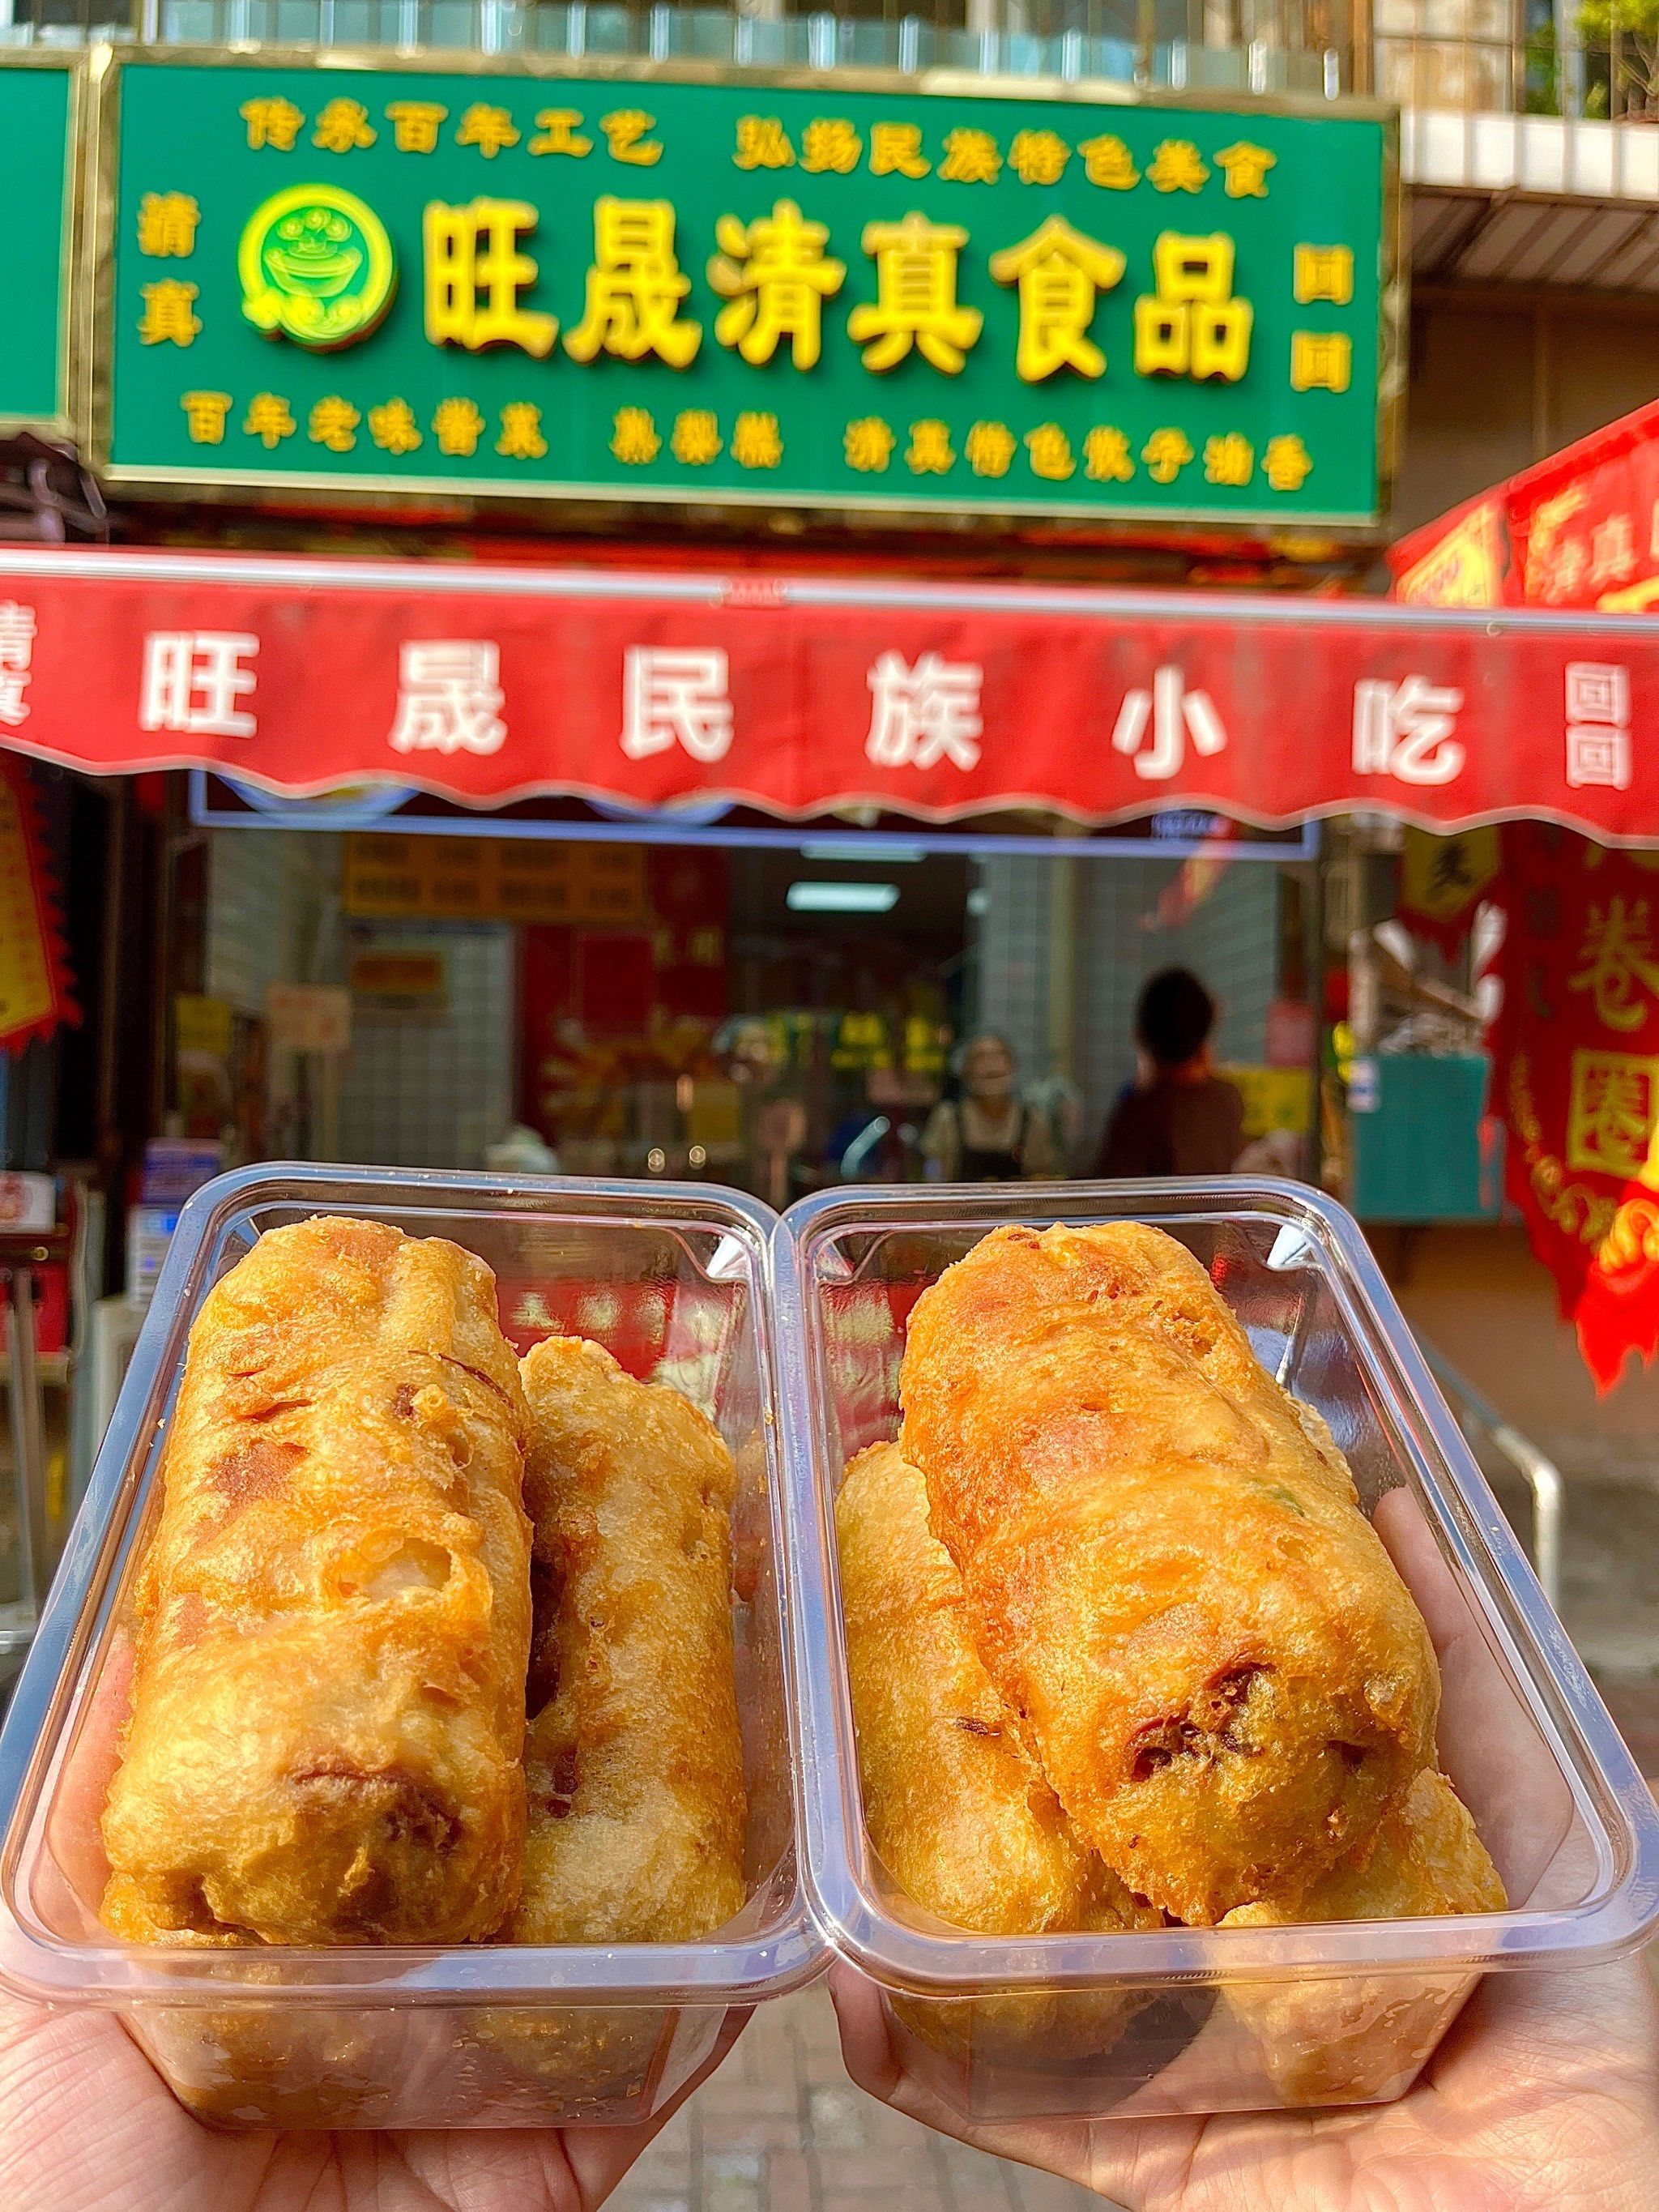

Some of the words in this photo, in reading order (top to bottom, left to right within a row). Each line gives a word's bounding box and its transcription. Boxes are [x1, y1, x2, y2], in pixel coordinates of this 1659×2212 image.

[239, 96, 664, 167] 传承百年工艺
[732, 115, 1277, 199] 弘扬民族特色美食
[422, 196, 1256, 386] 旺晟清真食品
[1289, 243, 1354, 394] 回回
[140, 630, 1465, 786] 旺晟民族小吃
[1564, 661, 1631, 789] 回回
[1567, 839, 1659, 1179] 卷圈
